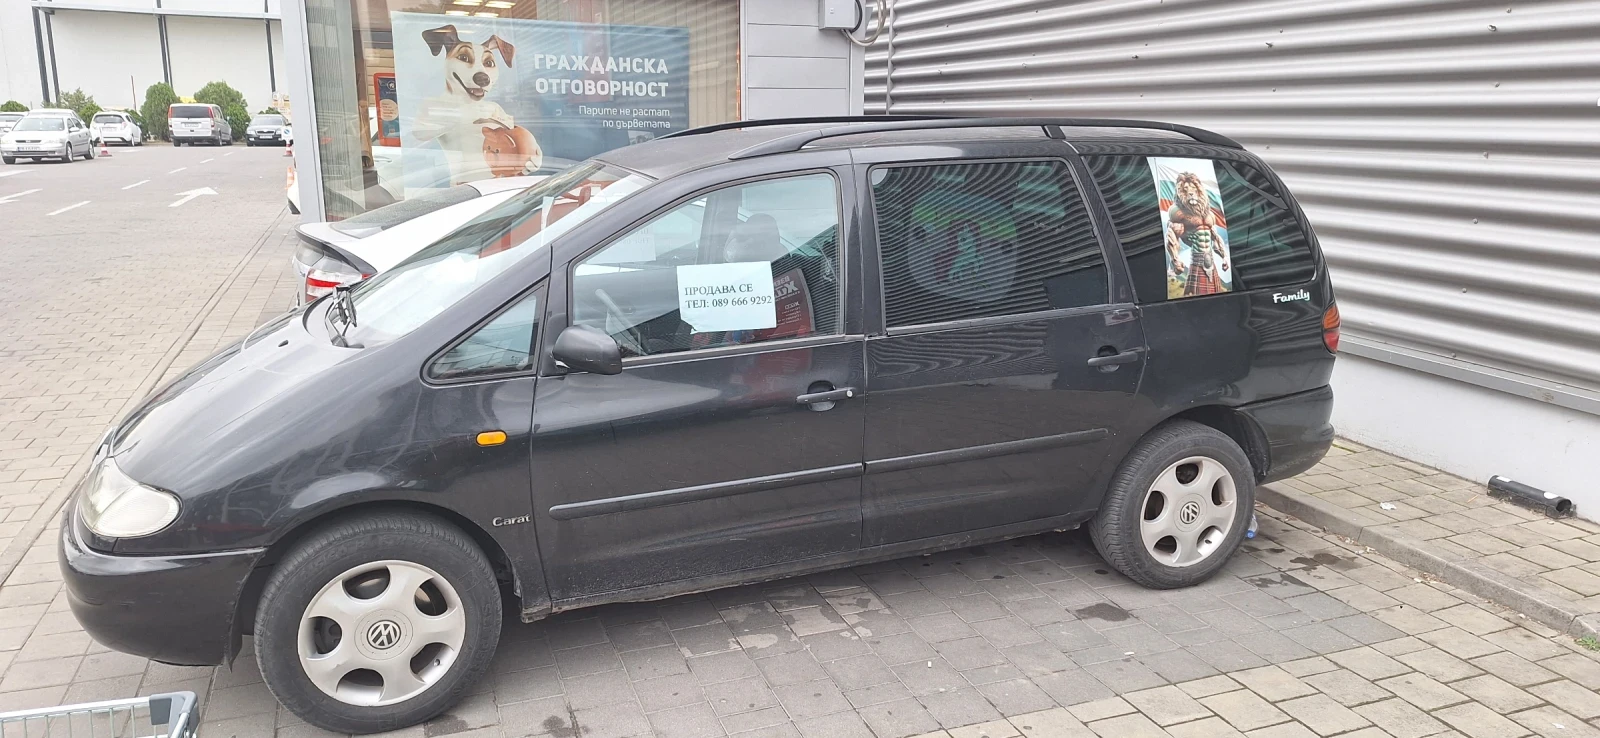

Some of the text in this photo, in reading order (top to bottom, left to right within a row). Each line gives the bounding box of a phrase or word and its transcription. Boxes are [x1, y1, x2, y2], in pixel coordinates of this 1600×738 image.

[534, 53, 669, 74] ГРАЖДАНСКА
[535, 77, 669, 97] ОТГОВОРНОСТ
[579, 105, 618, 117] Парите
[619, 108, 631, 116] не
[602, 118, 671, 129] по дърветата
[684, 283, 754, 296] ПРОДАВА СЕ
[1272, 288, 1310, 303] Family
[685, 299, 710, 309] ТЕЛ:
[712, 297, 729, 307] 089
[731, 296, 748, 306] 666
[750, 295, 772, 305] 9292
[492, 513, 531, 527] Carat
